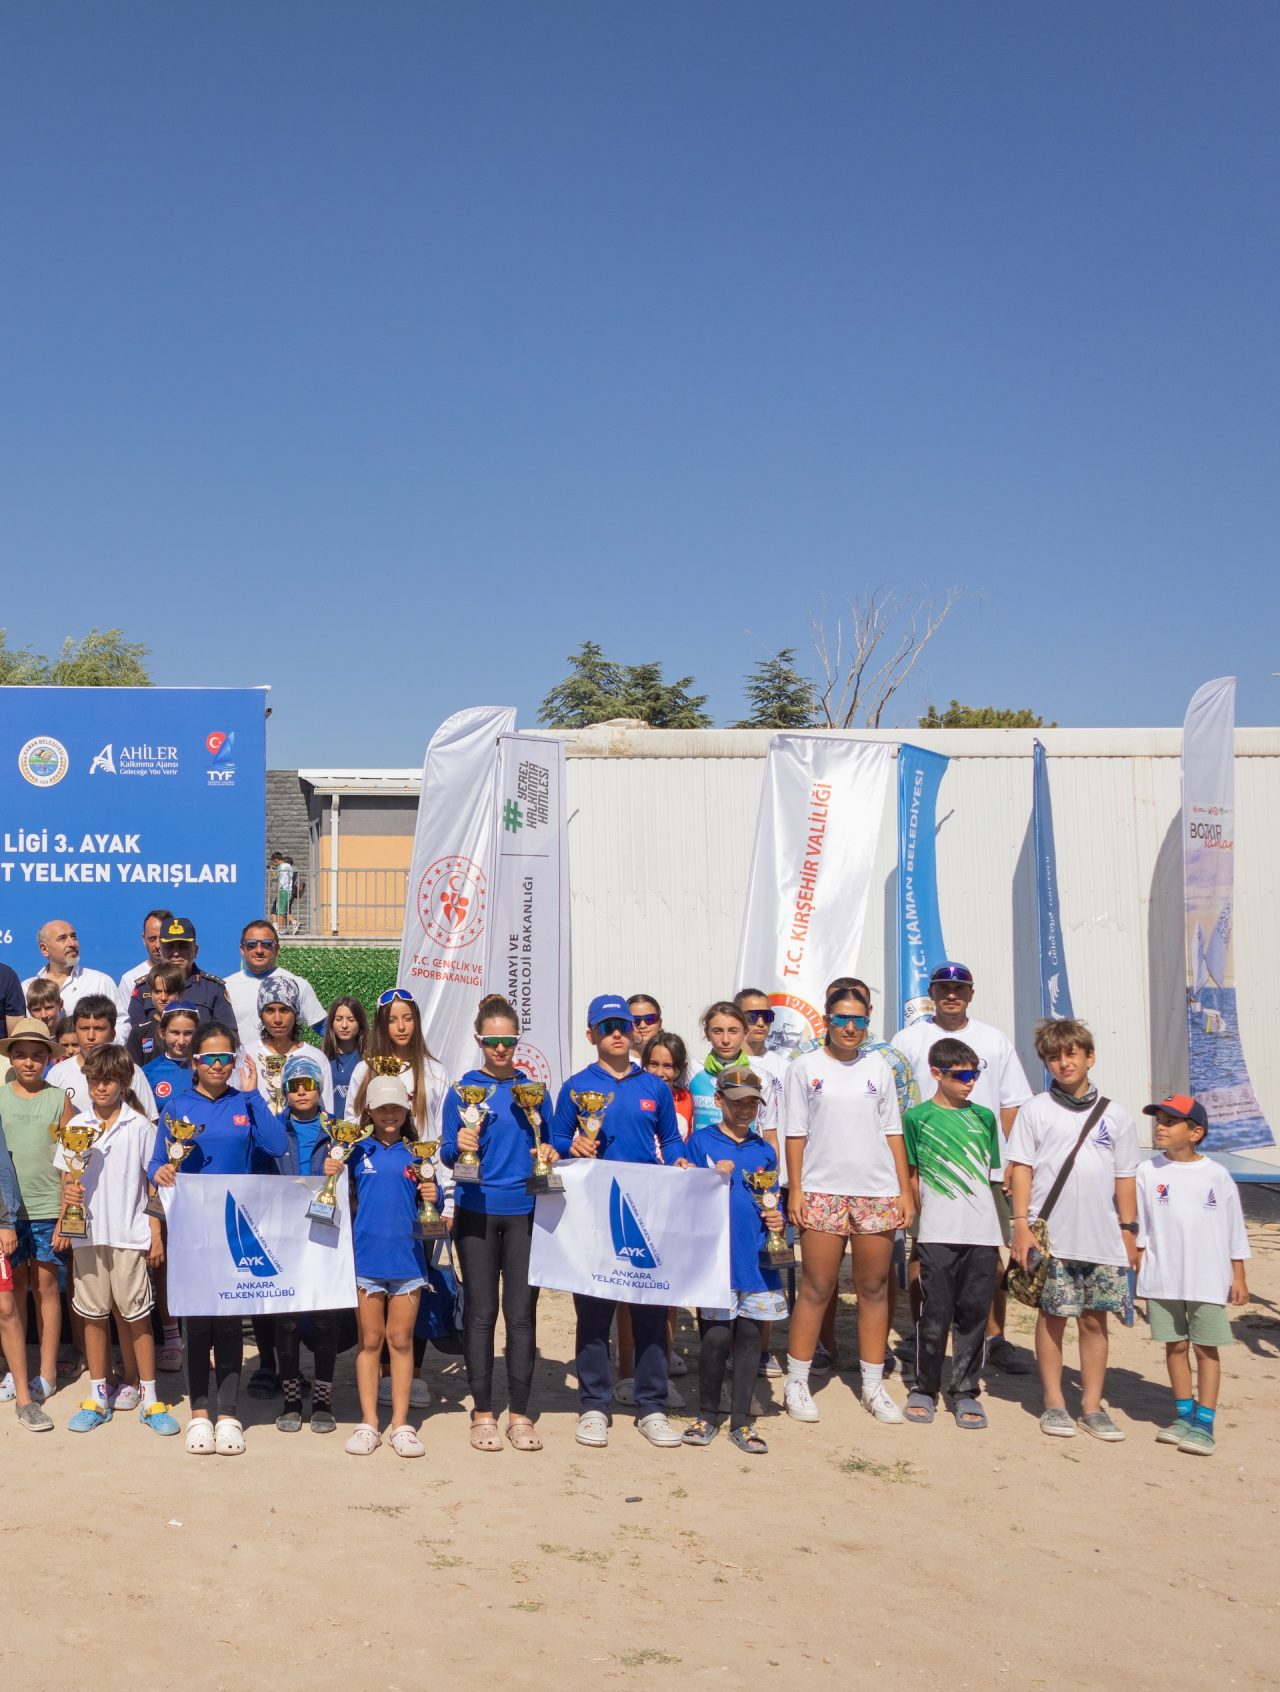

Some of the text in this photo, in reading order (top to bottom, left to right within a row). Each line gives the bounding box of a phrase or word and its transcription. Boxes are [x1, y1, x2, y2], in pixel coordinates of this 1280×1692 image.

[120, 743, 178, 760] AHİLER
[120, 760, 179, 769] Kalkınma Ajansı
[120, 768, 148, 777] Geleceğe
[206, 770, 235, 781] TYF
[517, 759, 529, 800] YEREL
[525, 762, 539, 829] KALKINMA
[537, 767, 550, 825] HAMLESİ
[4, 828, 48, 853] LİGİ
[54, 834, 74, 853] 3.
[80, 834, 141, 854] AYAK
[20, 863, 111, 883] YELKEN
[116, 863, 237, 887] YARIŞLARI
[783, 782, 832, 977] T.C. KIRŞEHİR VALİLİĞİ
[905, 769, 928, 982] T.C. KAMAN BELEDİYESİ
[520, 876, 533, 1034] TEKNOLOJİ BAKANLIĞI
[507, 933, 519, 1006] SANAYİ VE
[619, 1246, 645, 1257] AYK
[238, 1256, 265, 1266] AYK
[591, 1273, 670, 1290] YELKEN KULÜBÜ
[611, 1268, 652, 1280] ANKARA
[218, 1287, 296, 1300] YELKEN KULÜBÜ
[236, 1281, 275, 1290] ANKARA
